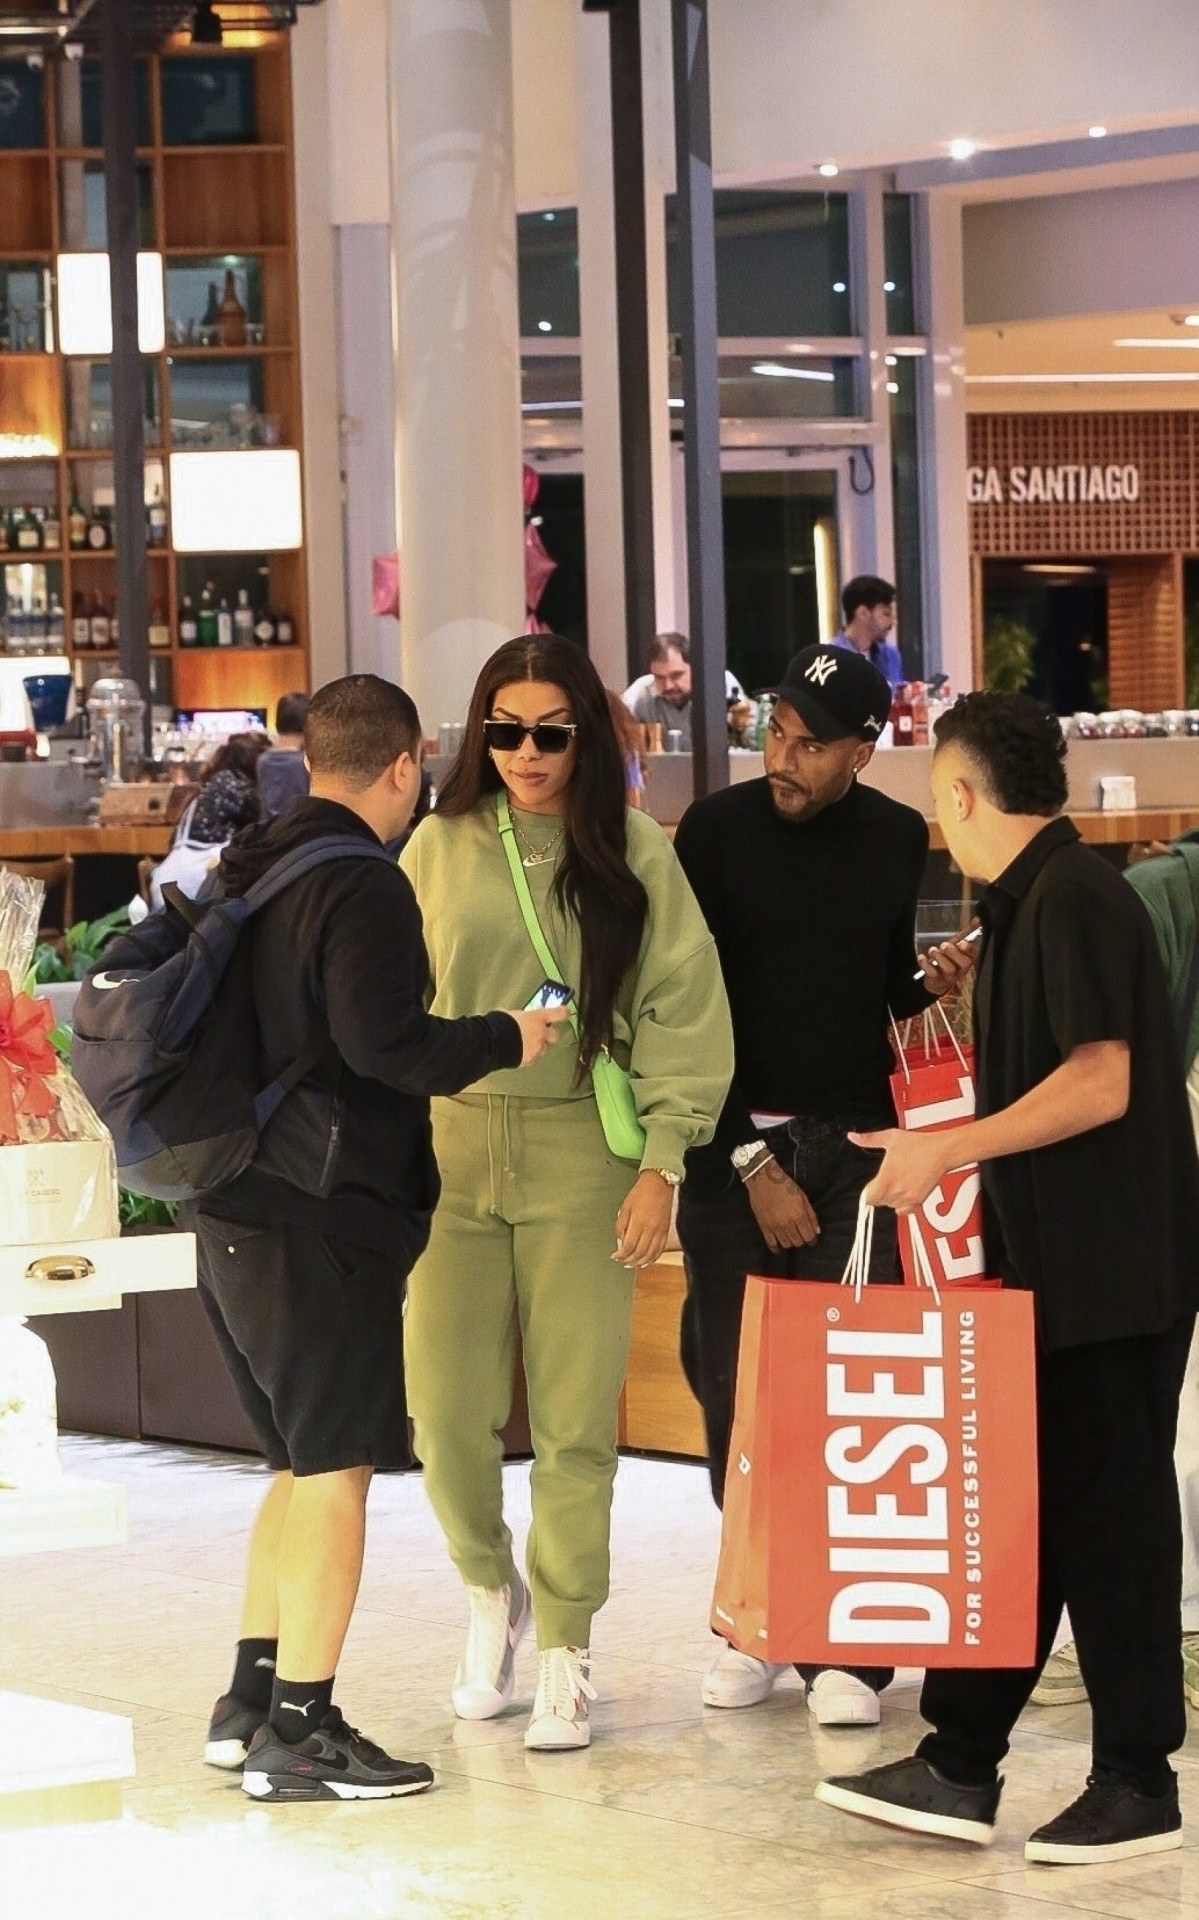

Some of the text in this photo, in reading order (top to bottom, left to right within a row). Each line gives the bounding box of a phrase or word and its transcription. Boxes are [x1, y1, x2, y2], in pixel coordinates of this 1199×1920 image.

[1010, 464, 1139, 501] SANTIAGO
[804, 654, 838, 686] NY
[904, 1076, 981, 1281] ESL
[958, 1310, 983, 1646] FOR SUCCESSFUL LIVING
